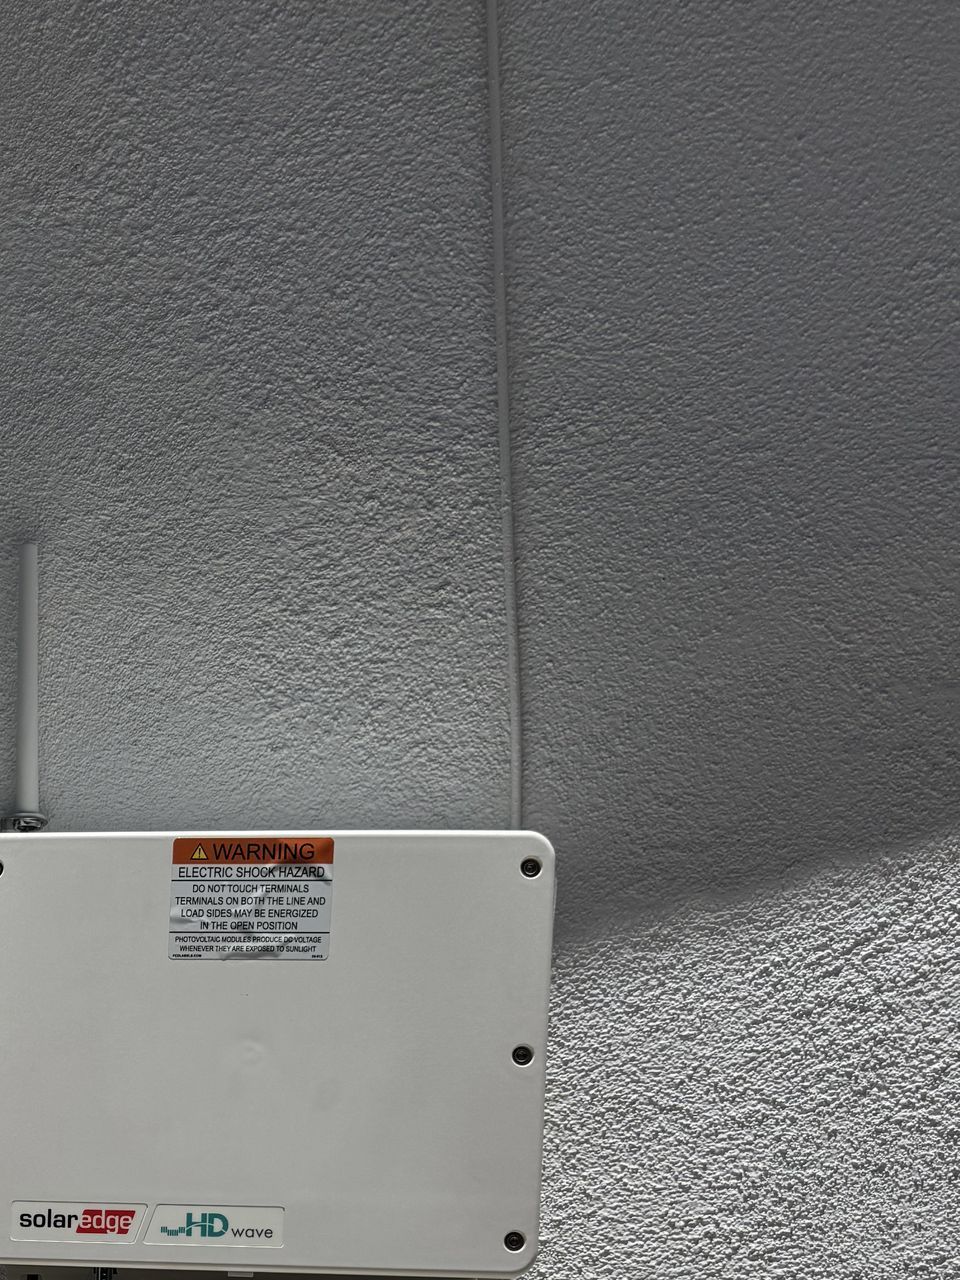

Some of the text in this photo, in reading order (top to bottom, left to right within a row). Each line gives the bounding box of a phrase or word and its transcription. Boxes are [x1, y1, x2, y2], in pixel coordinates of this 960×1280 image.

[213, 843, 315, 860] WARNING
[179, 867, 325, 878] ELECTRIC SHOCK HAZARD
[192, 885, 309, 893] DO NOT TOUCH TERMINALS
[176, 897, 325, 905] TERMINALS ON BOTH THE LINE AND
[181, 909, 318, 918] LOAD SIDES MAY BE ENERGIZED
[200, 922, 298, 930] IN THE OPEN POSITION
[19, 1209, 132, 1236] solaredge
[186, 1213, 273, 1239] HD wave
